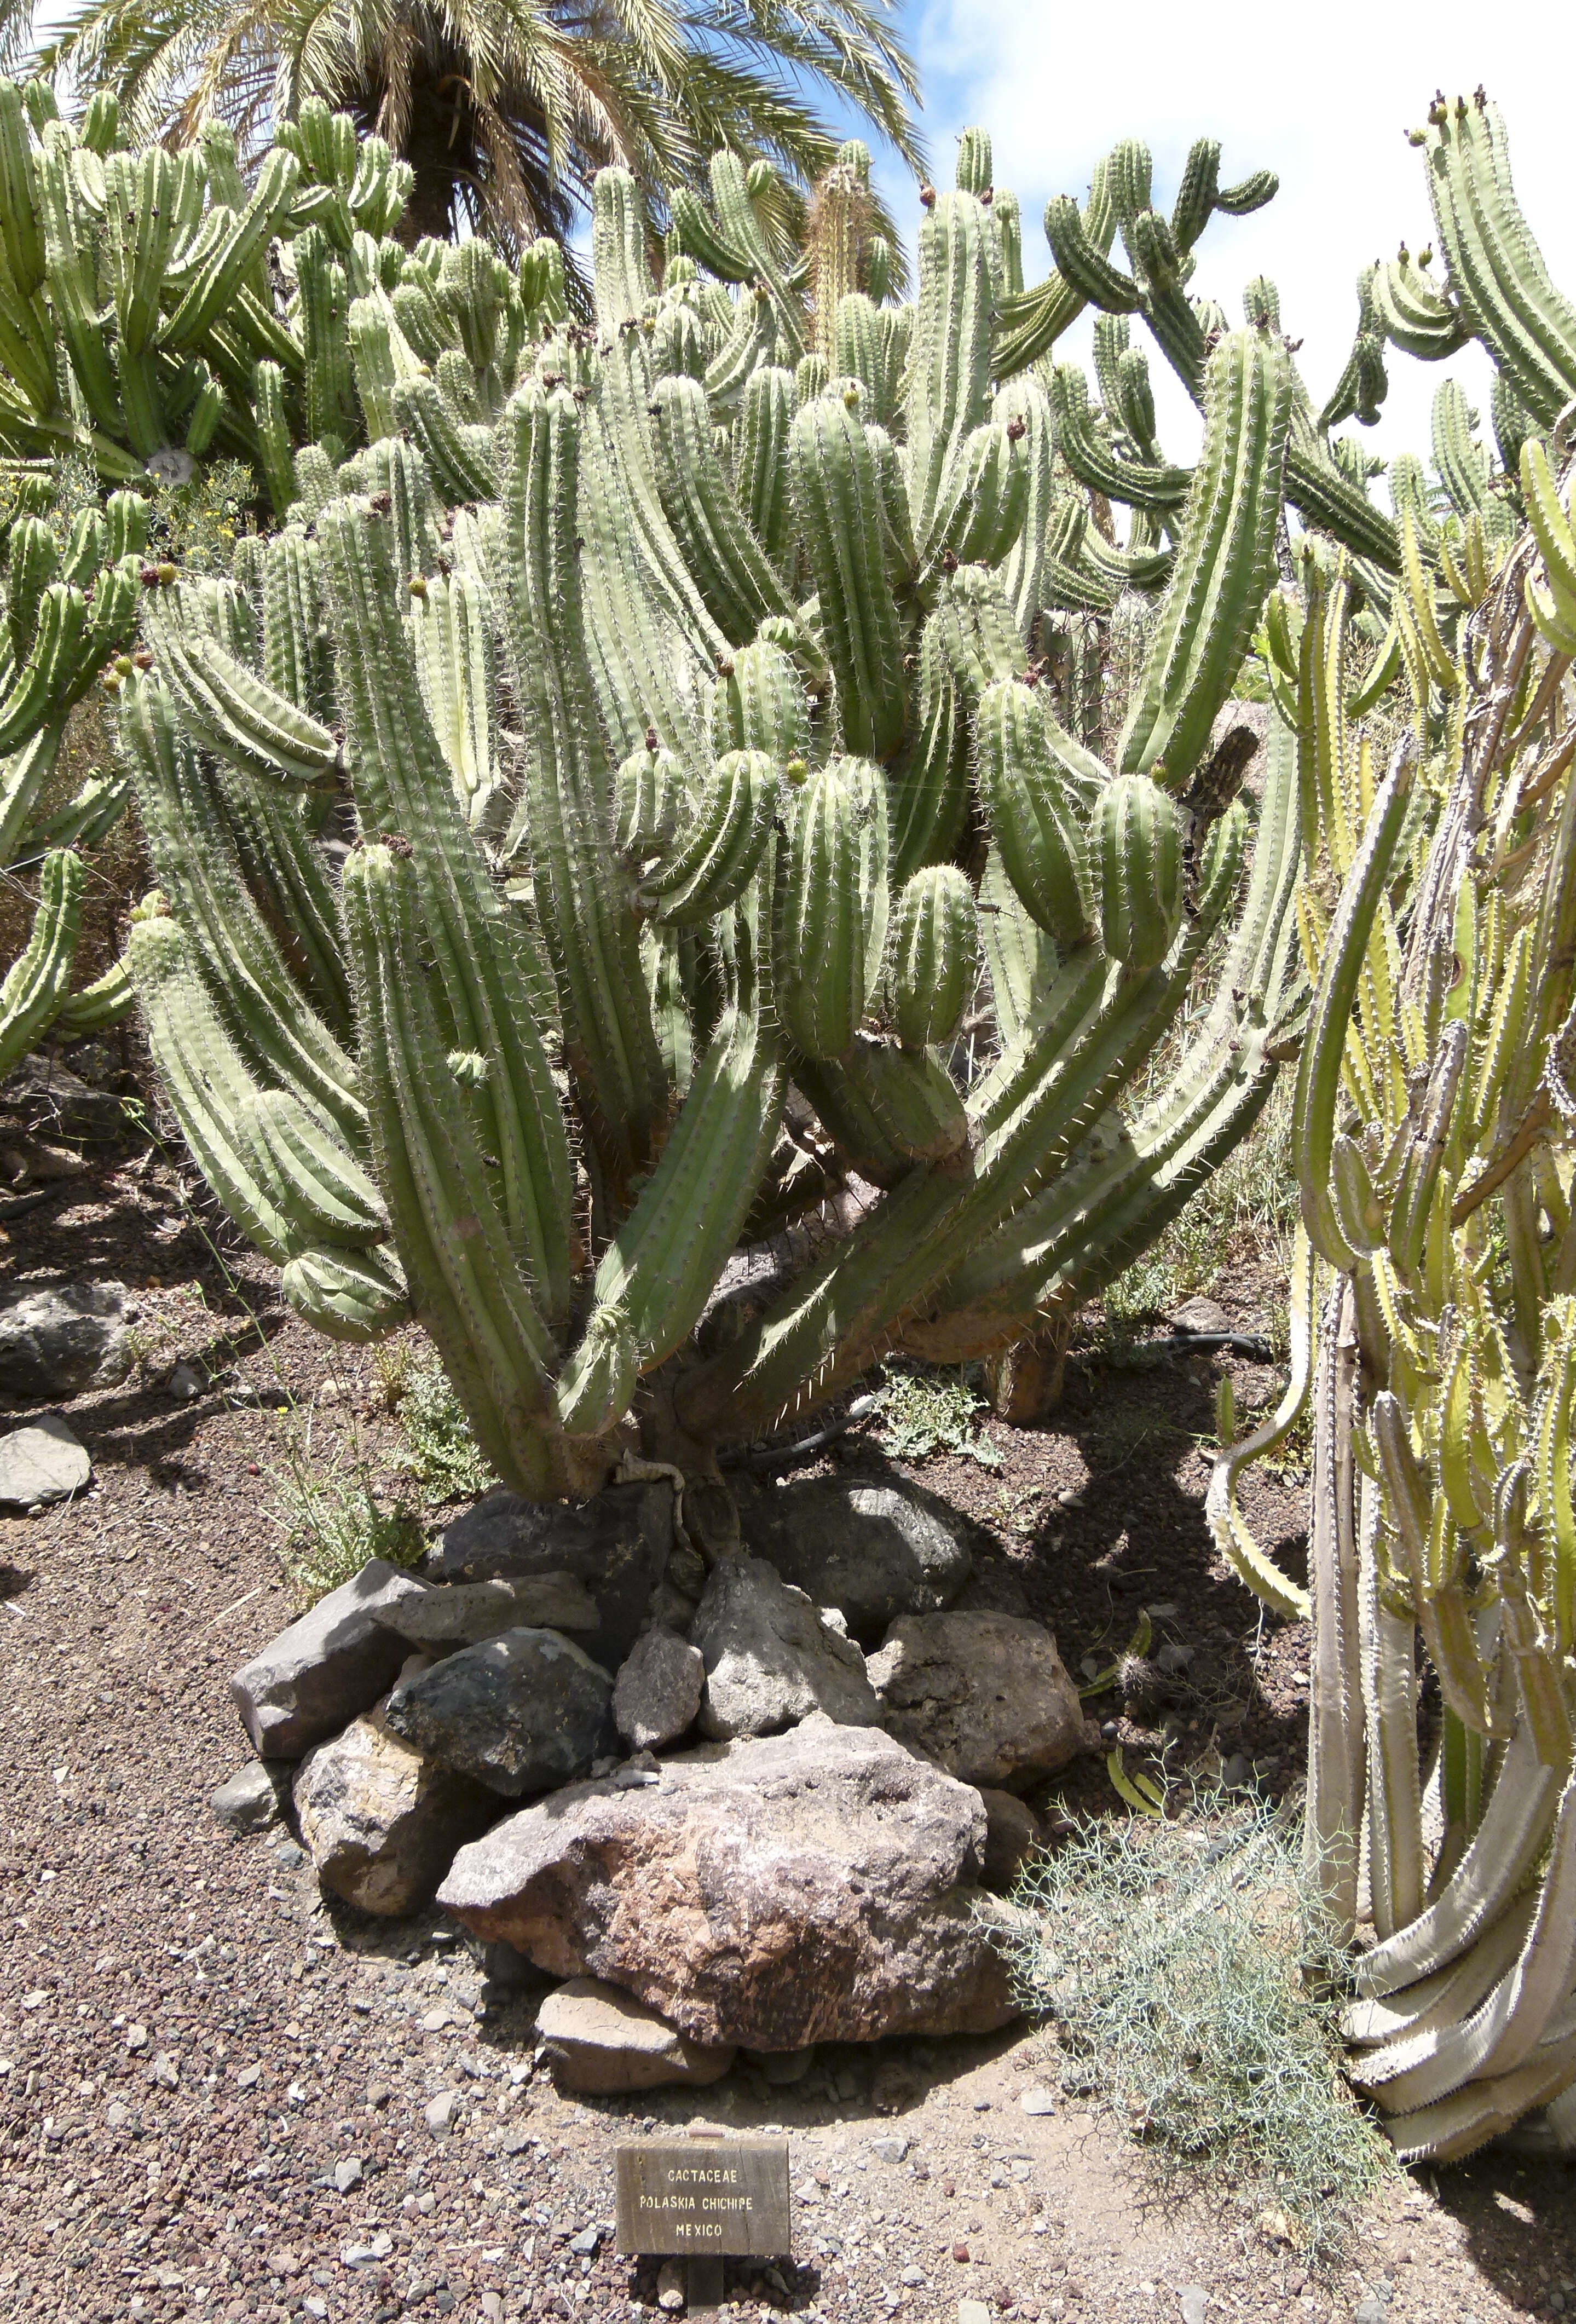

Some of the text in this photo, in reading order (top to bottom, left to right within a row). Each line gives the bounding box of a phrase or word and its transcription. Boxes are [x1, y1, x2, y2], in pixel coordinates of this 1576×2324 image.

[668, 2170, 737, 2183] CACTACEAE
[640, 2195, 753, 2210] POLASKIA CHICHIPE
[676, 2224, 722, 2236] MEXICO
